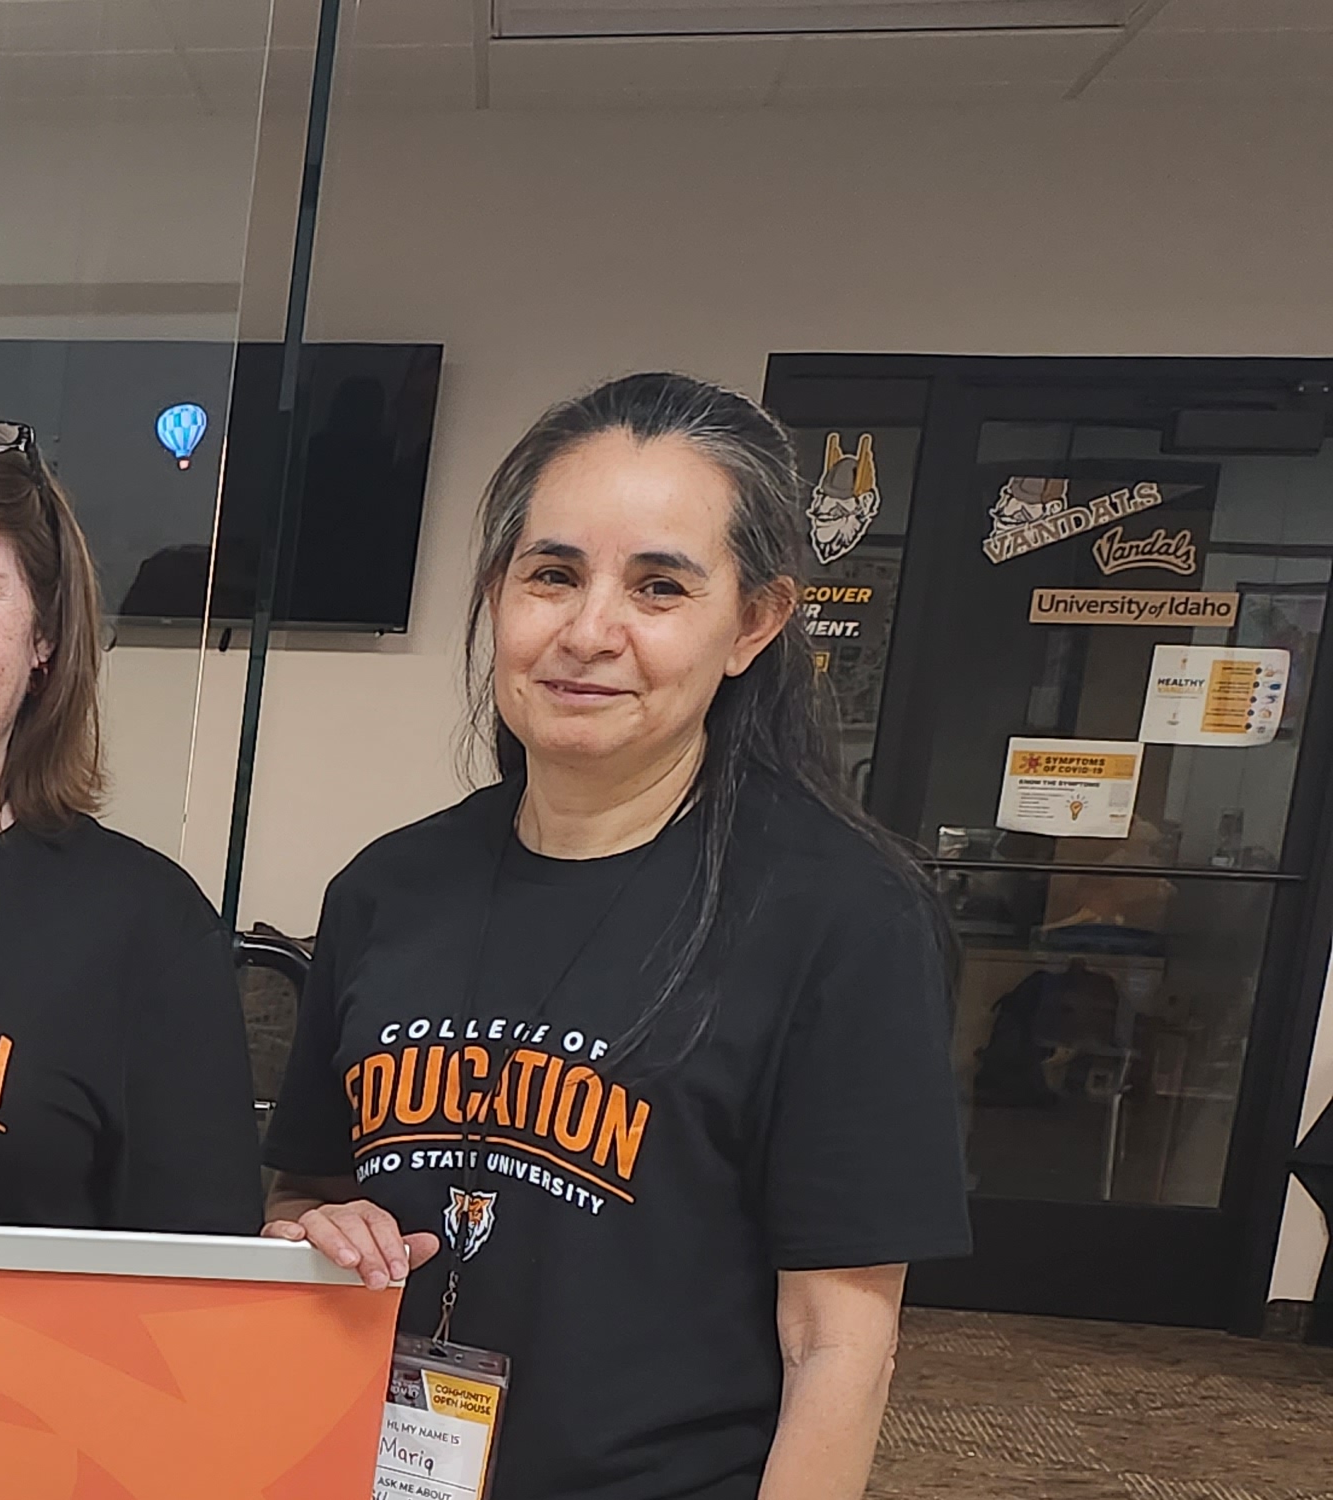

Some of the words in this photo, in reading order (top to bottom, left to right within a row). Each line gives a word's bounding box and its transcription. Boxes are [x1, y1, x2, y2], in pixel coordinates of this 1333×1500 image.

[983, 482, 1162, 564] VANDALS
[1092, 526, 1197, 576] Vandals
[803, 586, 873, 603] COVER
[1036, 593, 1149, 621] University
[1148, 600, 1167, 619] of
[1167, 596, 1232, 617] Idaho
[1157, 677, 1206, 688] HEALTHY
[1043, 765, 1056, 773] OF
[1057, 765, 1104, 774] COVID-19
[1044, 756, 1106, 766] SYMPTOMS
[562, 1030, 609, 1061] OF
[345, 1045, 651, 1181] EDUCATION
[410, 1150, 478, 1169] STATE
[486, 1153, 605, 1215] UNIVERSITY
[433, 1395, 460, 1411] OPEN
[461, 1400, 492, 1416] HOUSE
[435, 1383, 492, 1405] COMMUNITY
[400, 1421, 418, 1436] MY
[419, 1426, 449, 1443] NAME
[450, 1434, 461, 1445] IS
[377, 1477, 398, 1491] ASK
[399, 1480, 415, 1494] ME
